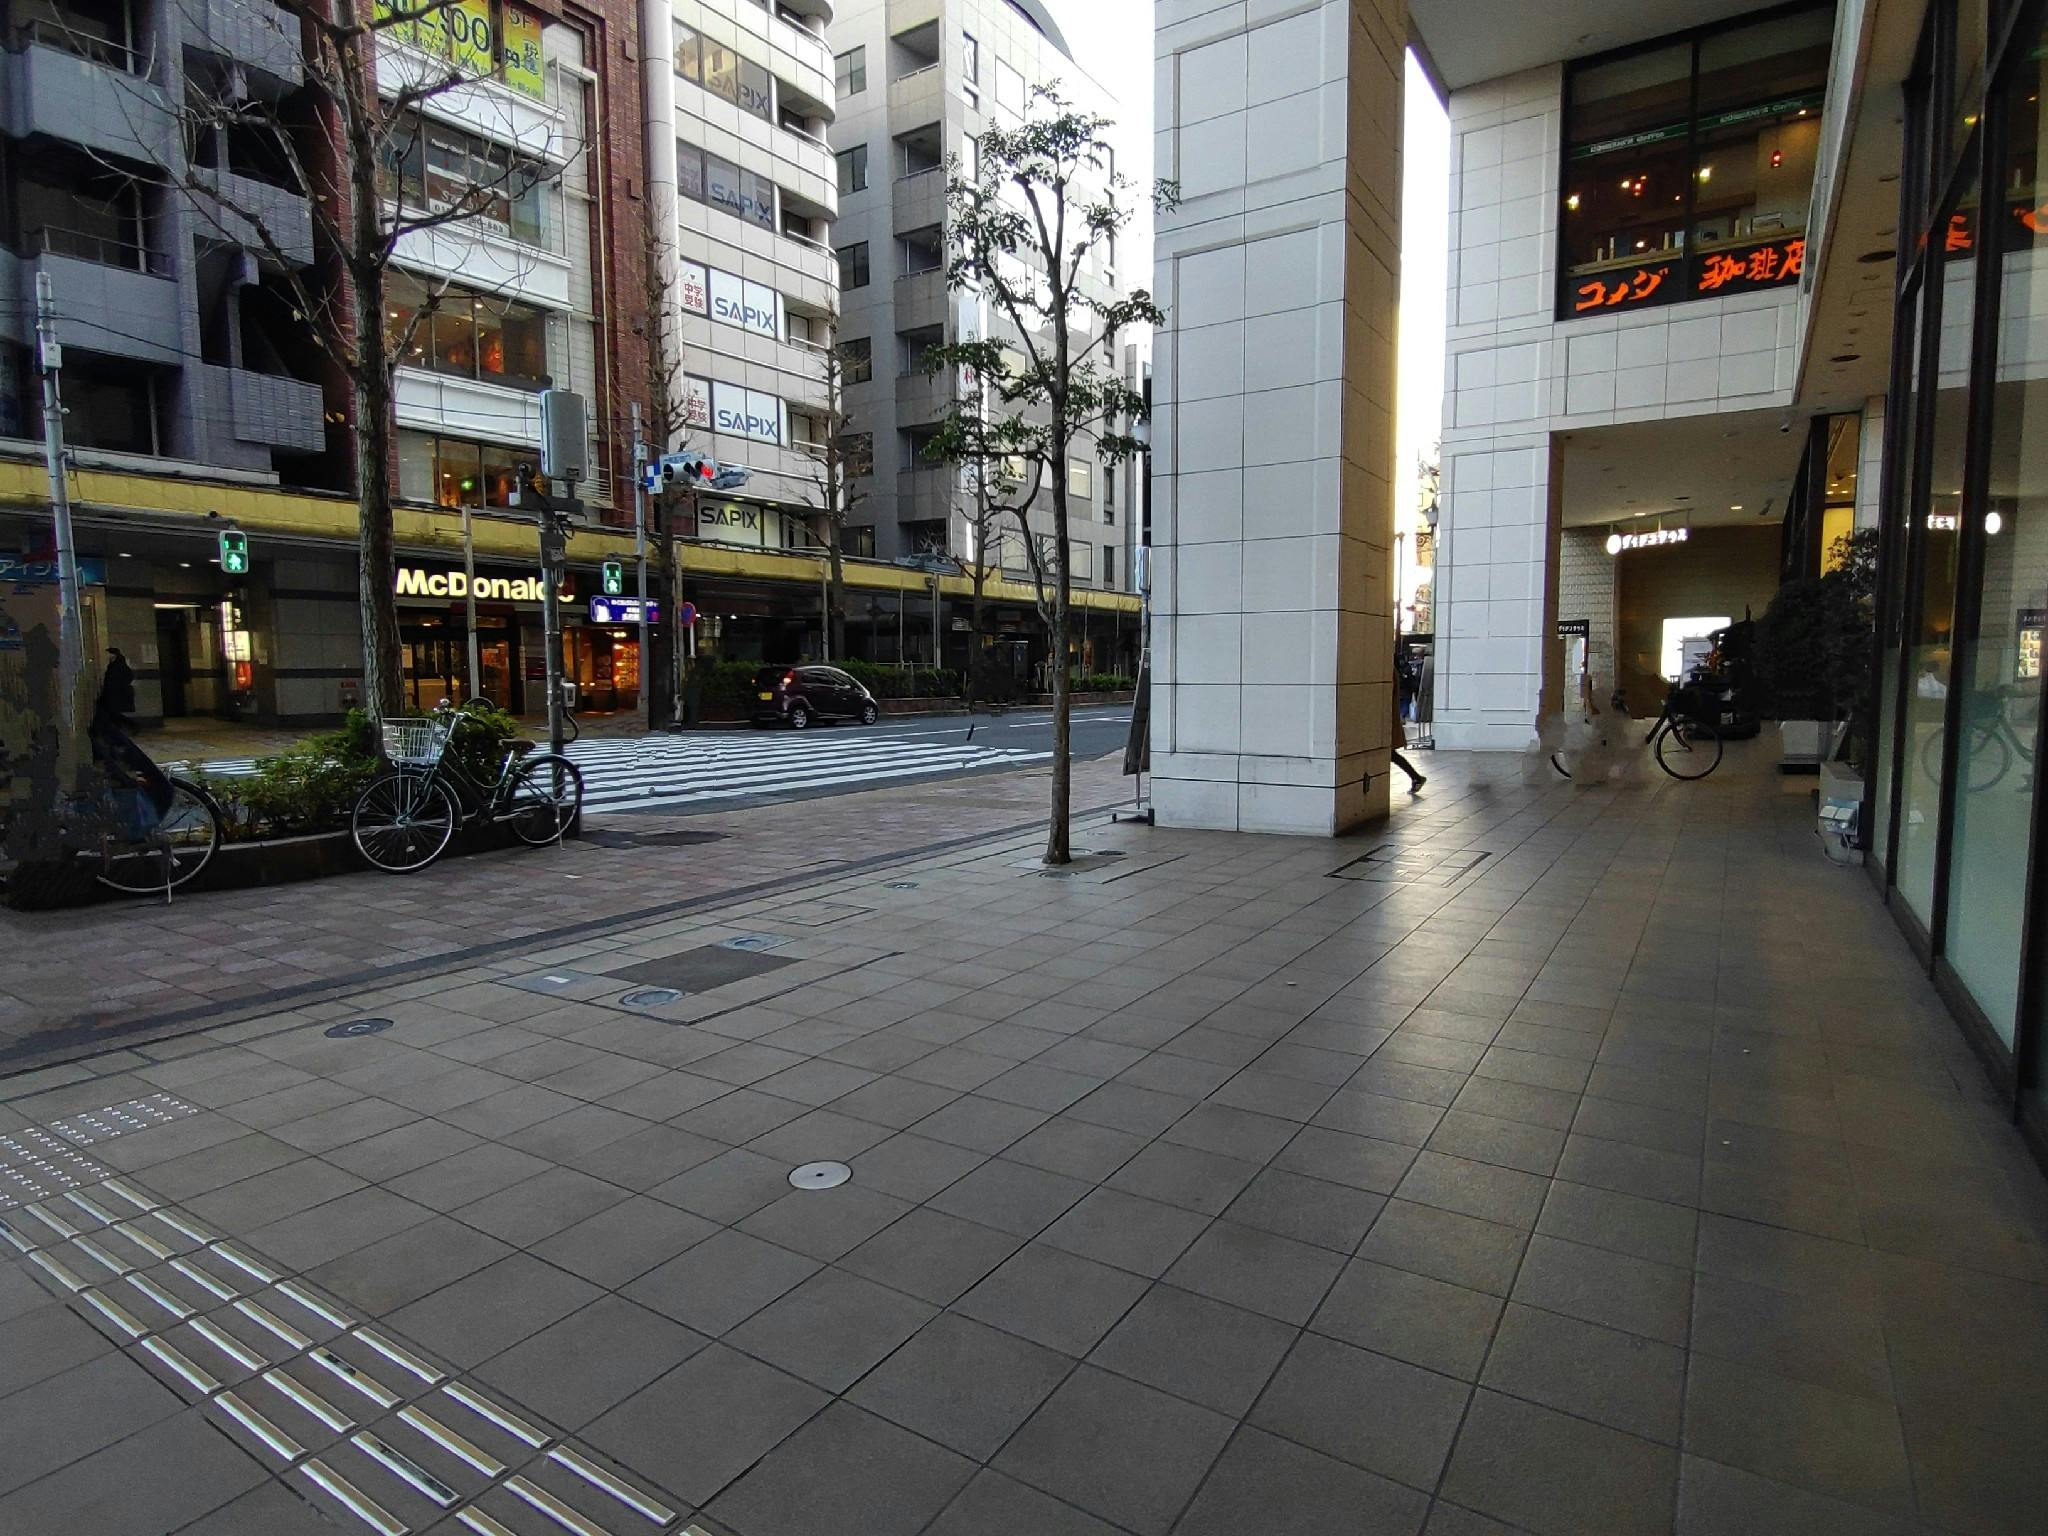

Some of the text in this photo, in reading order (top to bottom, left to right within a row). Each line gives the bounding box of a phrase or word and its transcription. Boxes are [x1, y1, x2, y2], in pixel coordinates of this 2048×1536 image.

[707, 75, 769, 118] SAPIX
[710, 182, 771, 225] SAPIX
[715, 296, 774, 332] SAPIX
[718, 409, 777, 438] SAPIX
[701, 506, 758, 530] SAPIX
